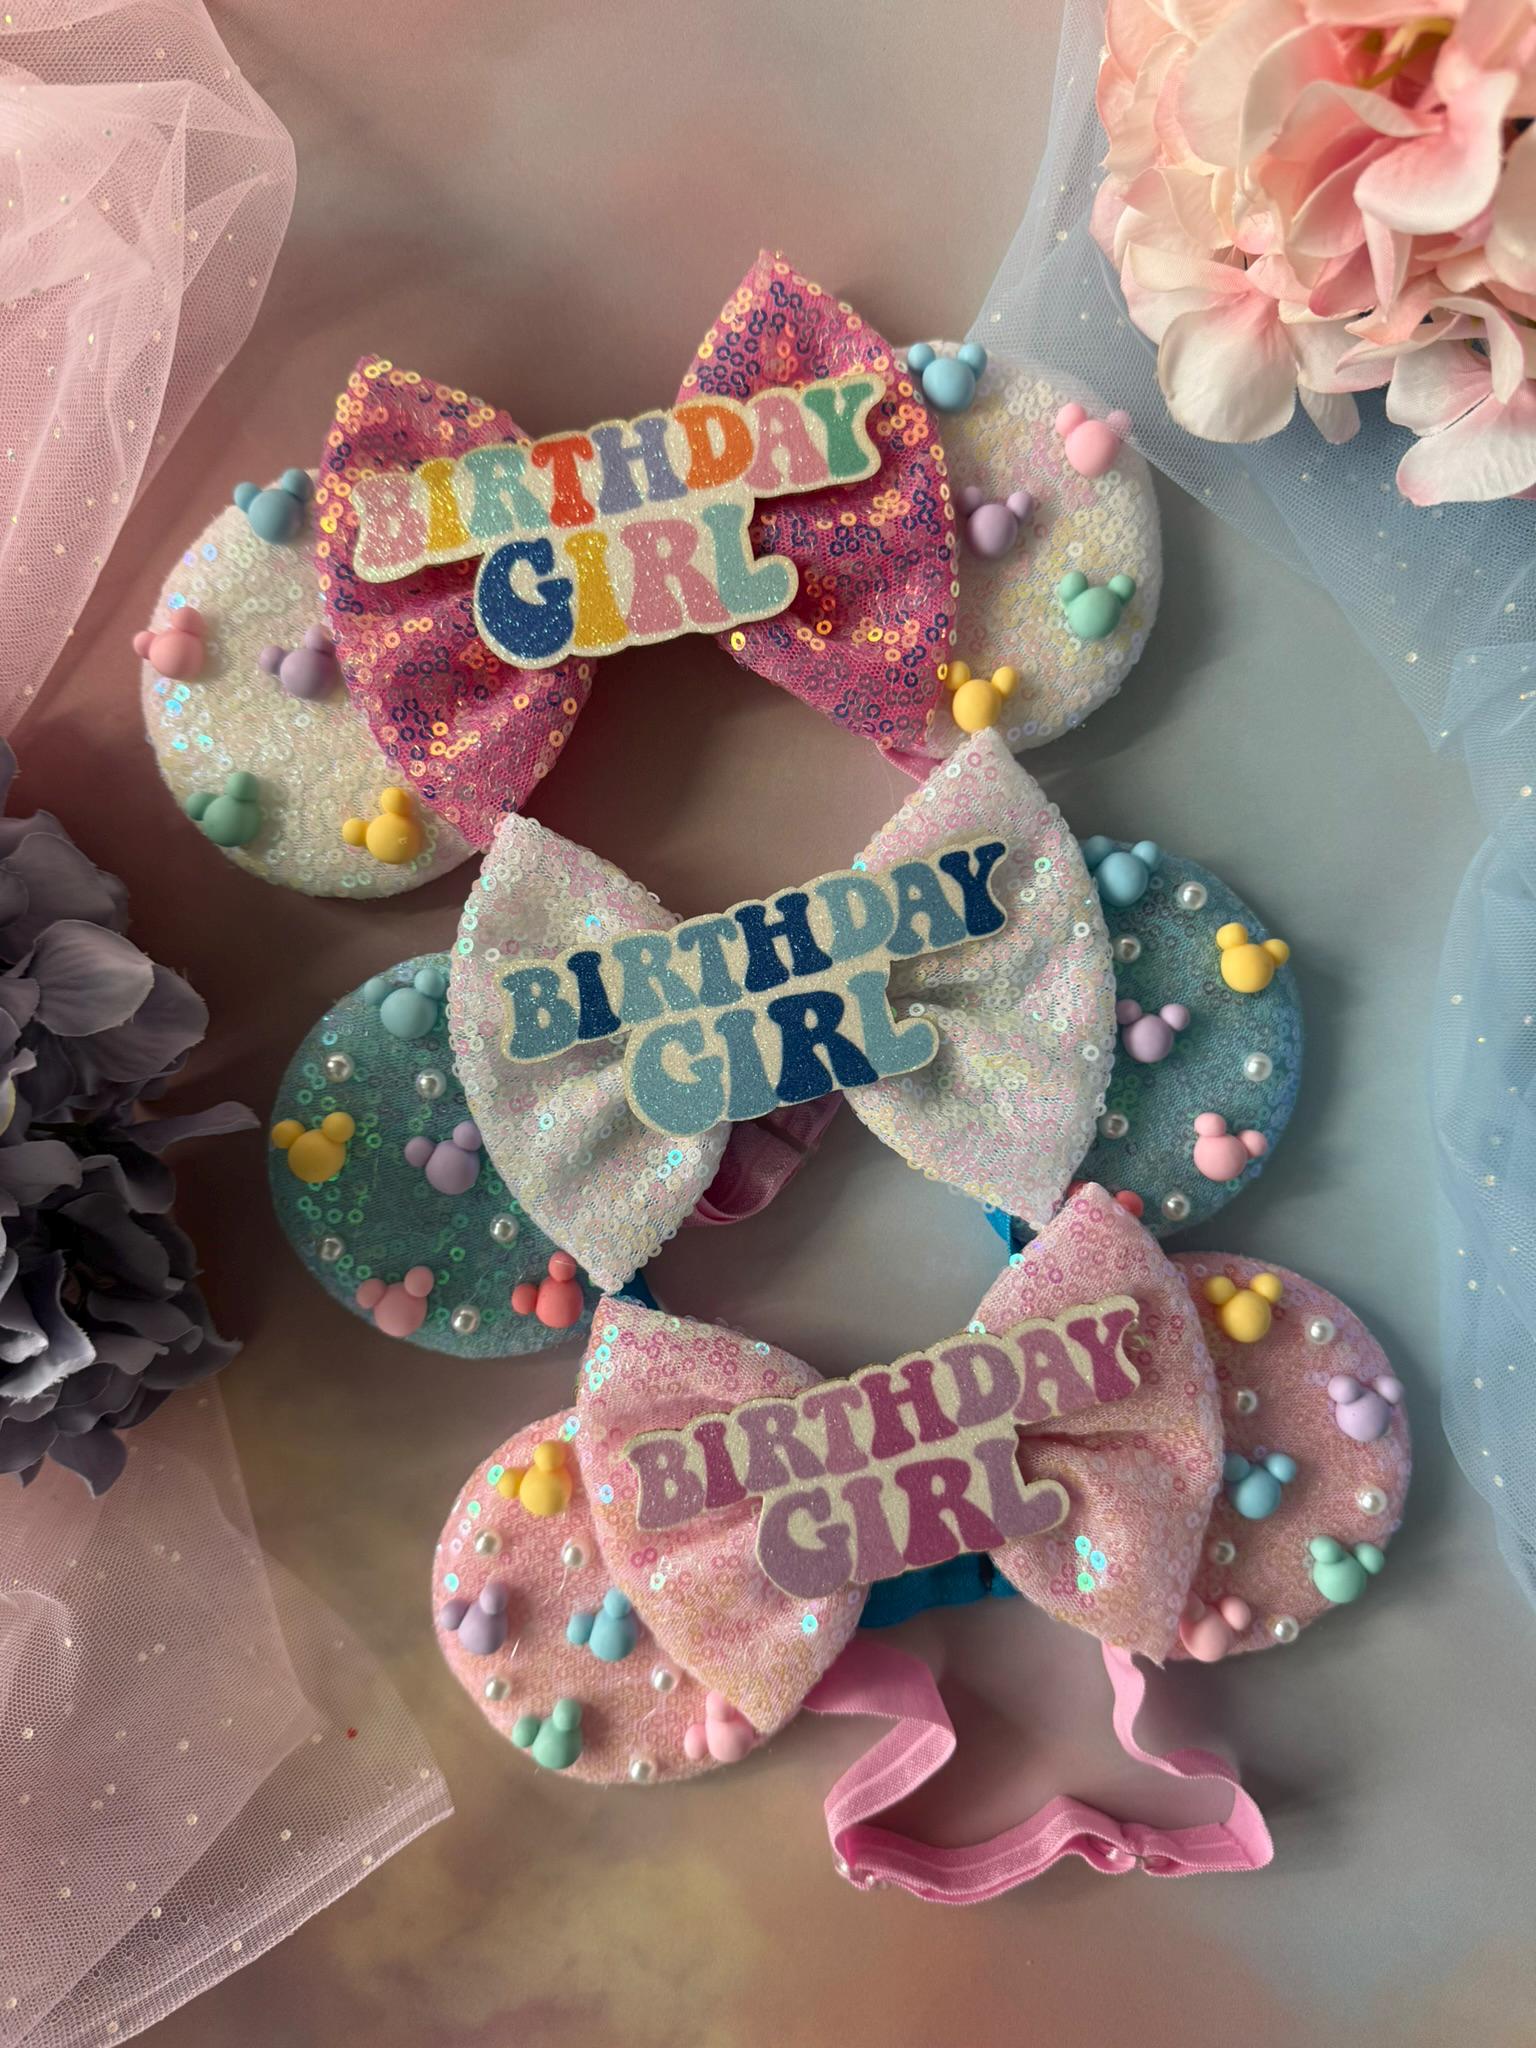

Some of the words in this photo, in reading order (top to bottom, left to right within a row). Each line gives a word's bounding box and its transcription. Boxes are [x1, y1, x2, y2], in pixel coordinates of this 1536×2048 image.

[353, 382, 875, 571] BIRTHDAY
[478, 503, 790, 659] GIRL
[502, 841, 1006, 1060] BIRTHDAY
[629, 970, 937, 1136] GIRL
[628, 1309, 1139, 1530] BIRTHDAY
[759, 1438, 1070, 1599] GIRL
